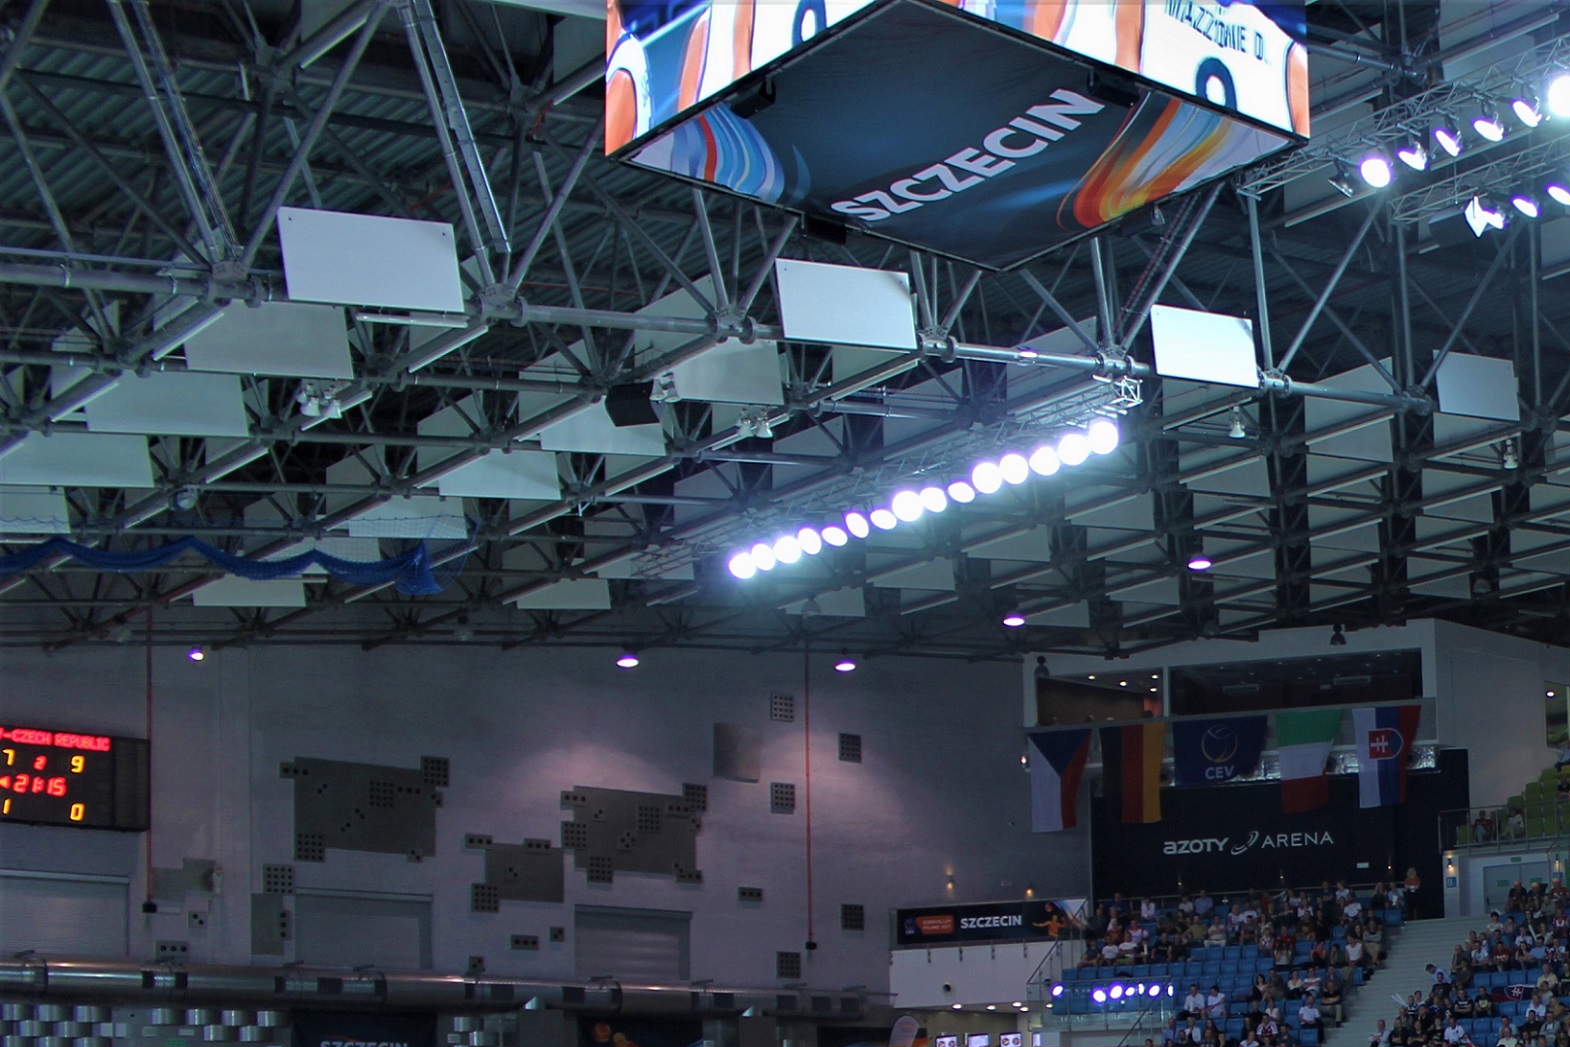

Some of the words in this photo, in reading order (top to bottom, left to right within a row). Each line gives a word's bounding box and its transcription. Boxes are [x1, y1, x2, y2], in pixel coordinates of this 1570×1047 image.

[831, 88, 1106, 223] SZCZECIN
[54, 733, 111, 752] REPUBLIC
[2, 748, 16, 766] 7
[33, 755, 48, 771] 2
[70, 755, 86, 773] 9
[1205, 764, 1235, 780] CEV
[69, 802, 86, 822] 0
[1261, 831, 1334, 849] ARENA
[960, 915, 1022, 930] SZCZECIN
